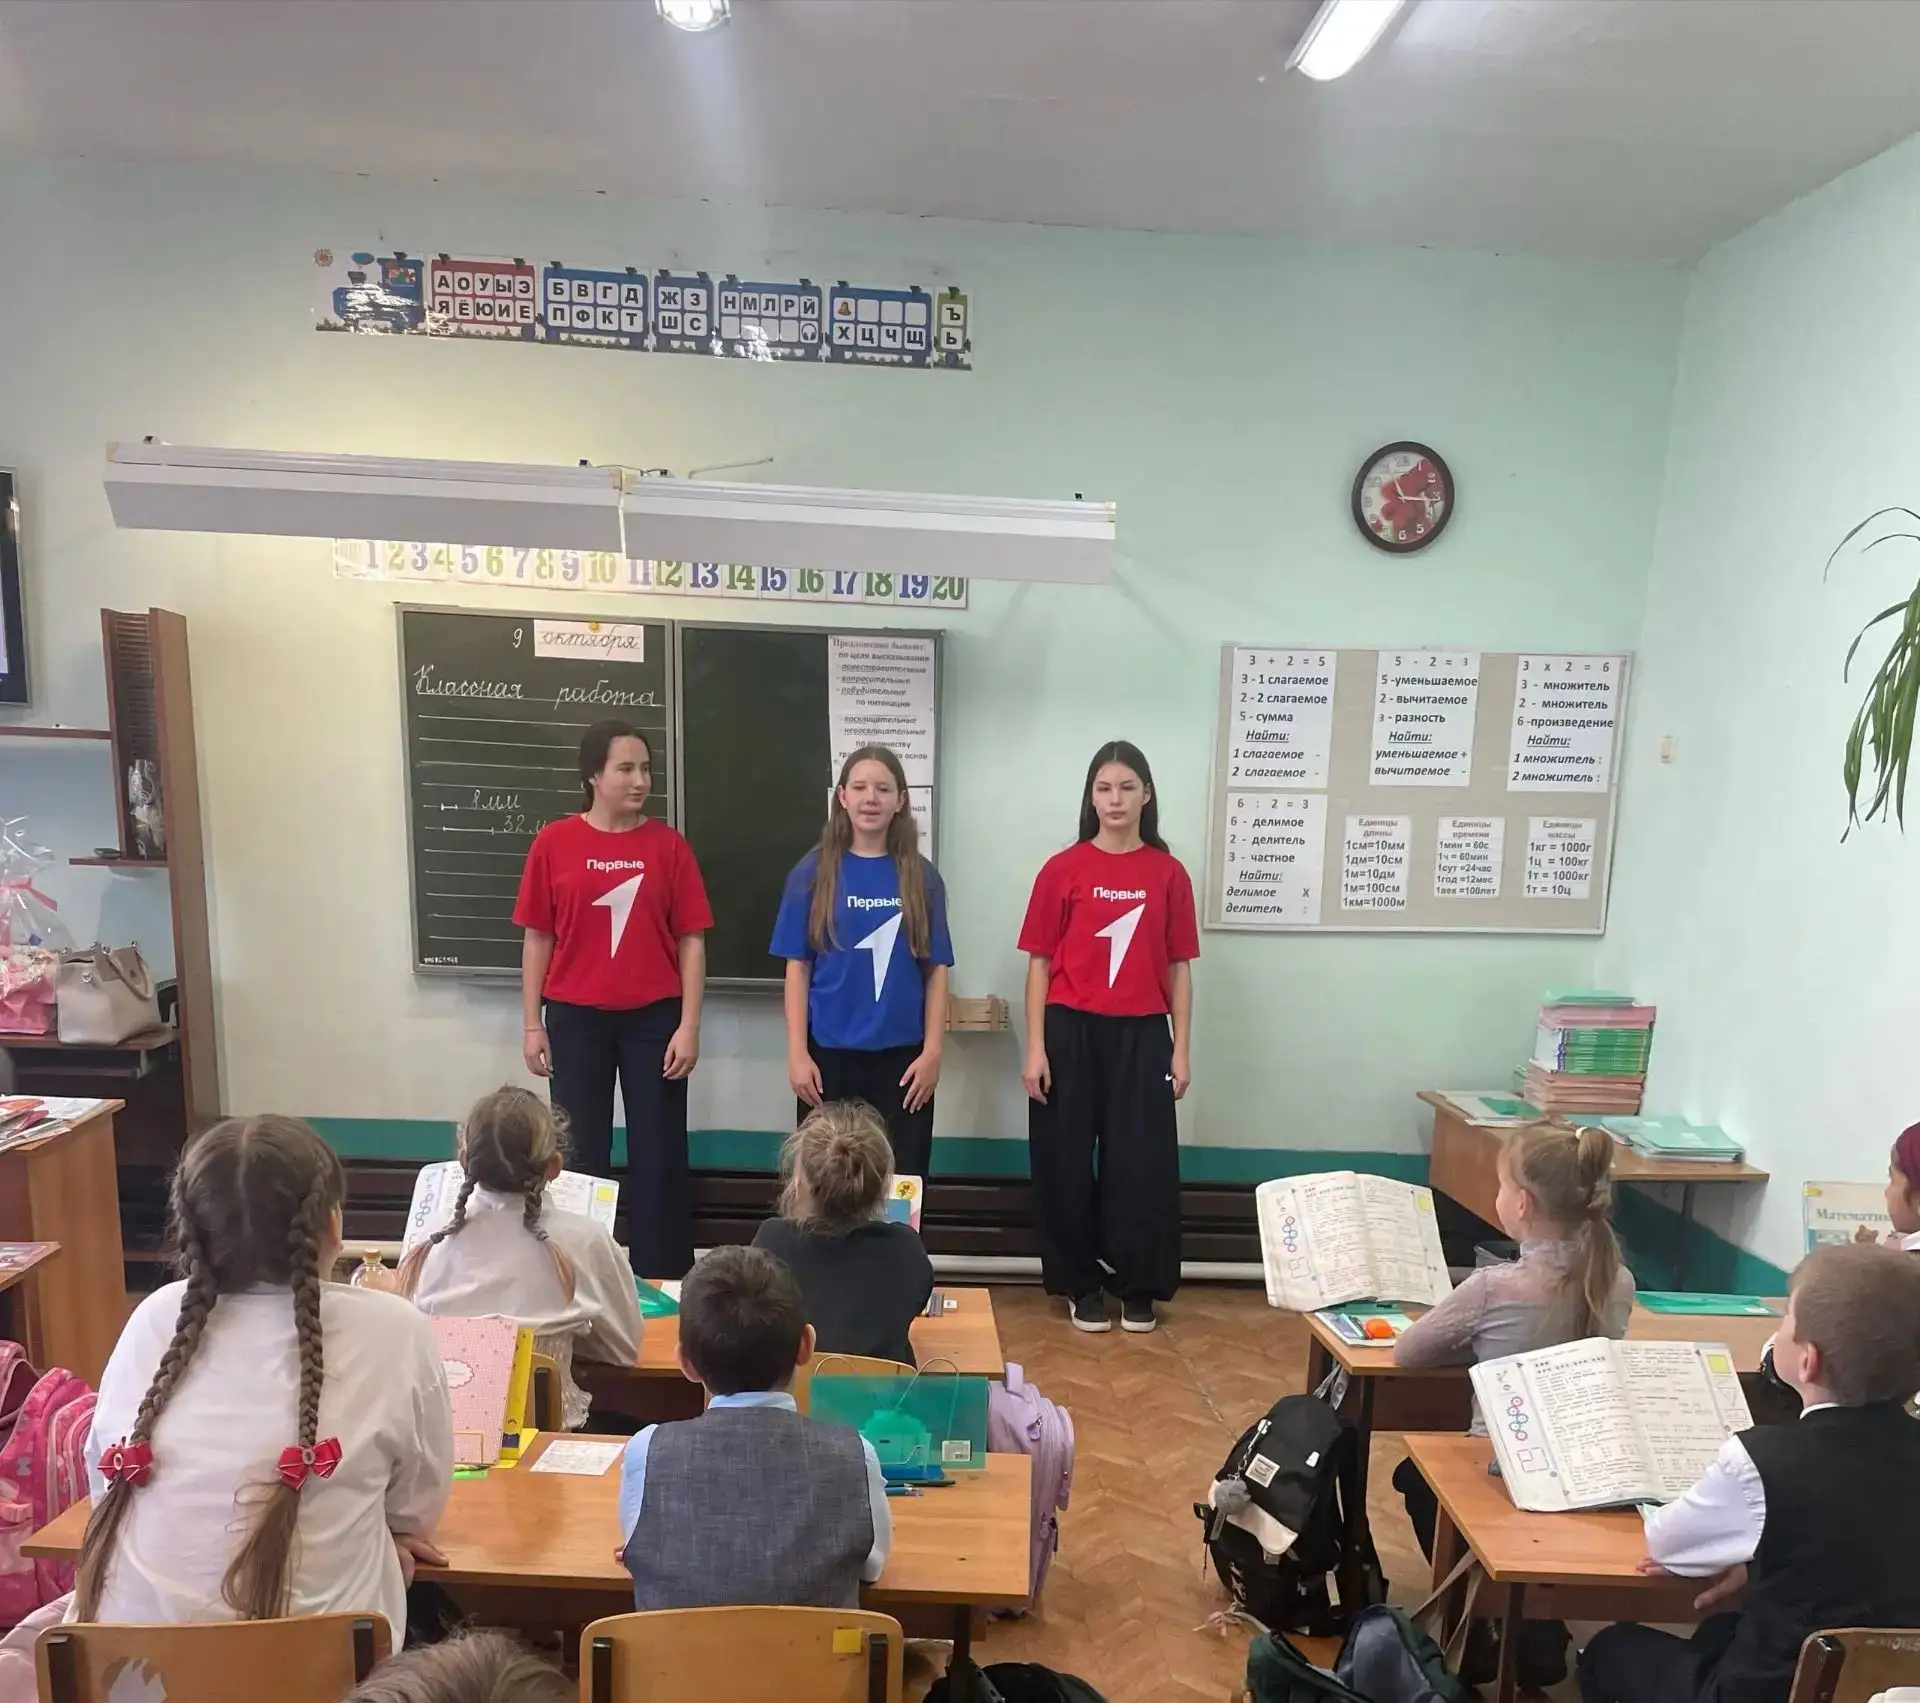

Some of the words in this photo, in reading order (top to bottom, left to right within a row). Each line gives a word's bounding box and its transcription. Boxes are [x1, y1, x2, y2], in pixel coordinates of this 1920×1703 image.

[438, 275, 449, 288] А
[458, 277, 470, 290] О
[479, 278, 489, 291] У
[495, 279, 511, 293] Ы
[518, 281, 530, 293] Э
[553, 282, 564, 296] Б
[578, 285, 588, 297] В
[602, 286, 612, 298] Г
[625, 288, 639, 303] Д
[660, 291, 679, 306] Ж
[438, 301, 449, 314] Я
[459, 300, 470, 316] Ё
[476, 303, 493, 317] Ю
[499, 304, 510, 318] И
[520, 305, 530, 319] Е
[724, 297, 736, 310] Н
[743, 297, 758, 310] М
[763, 298, 778, 312] Л
[785, 299, 795, 313] Р
[804, 297, 815, 315] Й
[553, 308, 564, 321] П
[576, 309, 590, 322] Ф
[602, 311, 613, 324] К
[625, 313, 638, 326] Т
[946, 308, 960, 321] Ъ
[661, 316, 678, 329] Ш
[689, 317, 701, 331] С
[838, 327, 850, 340] Х
[861, 328, 875, 344] Ц
[885, 329, 897, 342] Ч
[905, 330, 925, 346] Щ
[946, 334, 958, 345] Ь
[366, 541, 378, 568] 1
[388, 542, 405, 571] 2
[411, 542, 428, 571] 3
[434, 543, 453, 573] 4
[461, 544, 478, 574] 5
[486, 545, 503, 576] 6
[513, 547, 529, 578] 7
[536, 549, 554, 579] 8
[562, 551, 579, 581] 9
[588, 552, 616, 583] 10
[628, 560, 652, 585] 11
[655, 561, 682, 587] 12
[689, 562, 719, 588] 13
[726, 565, 755, 590] 14
[760, 567, 787, 592] 15
[797, 569, 823, 593] 16
[833, 570, 858, 595] 17
[865, 572, 893, 597] 18
[900, 574, 929, 598] 19
[932, 576, 964, 600] 20
[513, 627, 523, 648] 9
[543, 625, 638, 656] октября
[1249, 655, 1256, 665] 3
[1287, 656, 1294, 666] 2
[1318, 656, 1325, 666] 5
[1395, 656, 1401, 666] 5
[1429, 657, 1436, 667] 2
[1522, 661, 1529, 671] 3
[1565, 662, 1572, 672] 2
[1603, 662, 1609, 672] 6
[1241, 674, 1248, 684] 3
[1259, 674, 1264, 684] 1
[1268, 676, 1329, 686] слагаемое
[1381, 675, 1388, 685] 5
[1521, 679, 1528, 689] 3
[1543, 681, 1610, 691] множитель
[413, 664, 524, 699] Классная
[554, 680, 659, 710] работа
[1240, 693, 1247, 703] 2
[1257, 693, 1263, 703] 2
[1267, 694, 1328, 704] слагаемое
[1380, 693, 1386, 703] 2
[1396, 695, 1468, 705] вычитаемое
[1519, 698, 1526, 708] 2
[1542, 700, 1608, 710] множитель
[1240, 711, 1246, 721] 5
[1256, 713, 1293, 723] сумма
[1395, 714, 1446, 724] разность
[1517, 716, 1524, 726] 6
[1246, 730, 1289, 741] Найти:
[1389, 731, 1433, 742] Найти:
[1527, 734, 1571, 746] Найти:
[1233, 748, 1239, 758] 1
[1243, 750, 1304, 760] слагаемое
[1376, 750, 1458, 760] уменьшаемое
[1513, 753, 1520, 763] 1
[1523, 755, 1595, 765] множитель
[1232, 767, 1239, 776] 2
[1245, 768, 1306, 778] слагаемое
[1375, 767, 1450, 776] вычитаемое
[1512, 771, 1520, 781] 2
[1521, 772, 1594, 782] множитель
[1238, 798, 1244, 808] 6
[1271, 799, 1278, 809] 2
[1302, 800, 1309, 809] 3
[1231, 816, 1237, 826] 6
[1252, 819, 1304, 828] делимое
[1230, 834, 1236, 844] 2
[1252, 837, 1306, 846] делитель
[1346, 840, 1405, 850] 1см=10мм
[1440, 841, 1463, 849] 1мин
[1530, 842, 1546, 852] 1кг
[1561, 842, 1591, 853] 1000г
[1229, 852, 1235, 862] 3
[1251, 854, 1295, 863] частное
[1345, 854, 1403, 866] 1дм=10см
[1460, 852, 1488, 860] 60мин
[1528, 856, 1541, 867] 1ц
[1559, 856, 1589, 867] 100кг
[586, 859, 645, 873] Первые
[1240, 870, 1282, 881] Найти:
[1345, 868, 1395, 880] 1м=10дм
[1527, 870, 1539, 880] 1т
[1553, 871, 1590, 881] 1000кг
[1093, 887, 1147, 901] Первые
[1226, 886, 1276, 897] делимое
[1344, 883, 1400, 893] 1м=100см
[1526, 884, 1538, 894] 1т
[1552, 885, 1571, 896] 10ц
[847, 896, 903, 911] Первые
[1226, 902, 1283, 914] делитель
[1343, 897, 1405, 907] 1км=1000м
